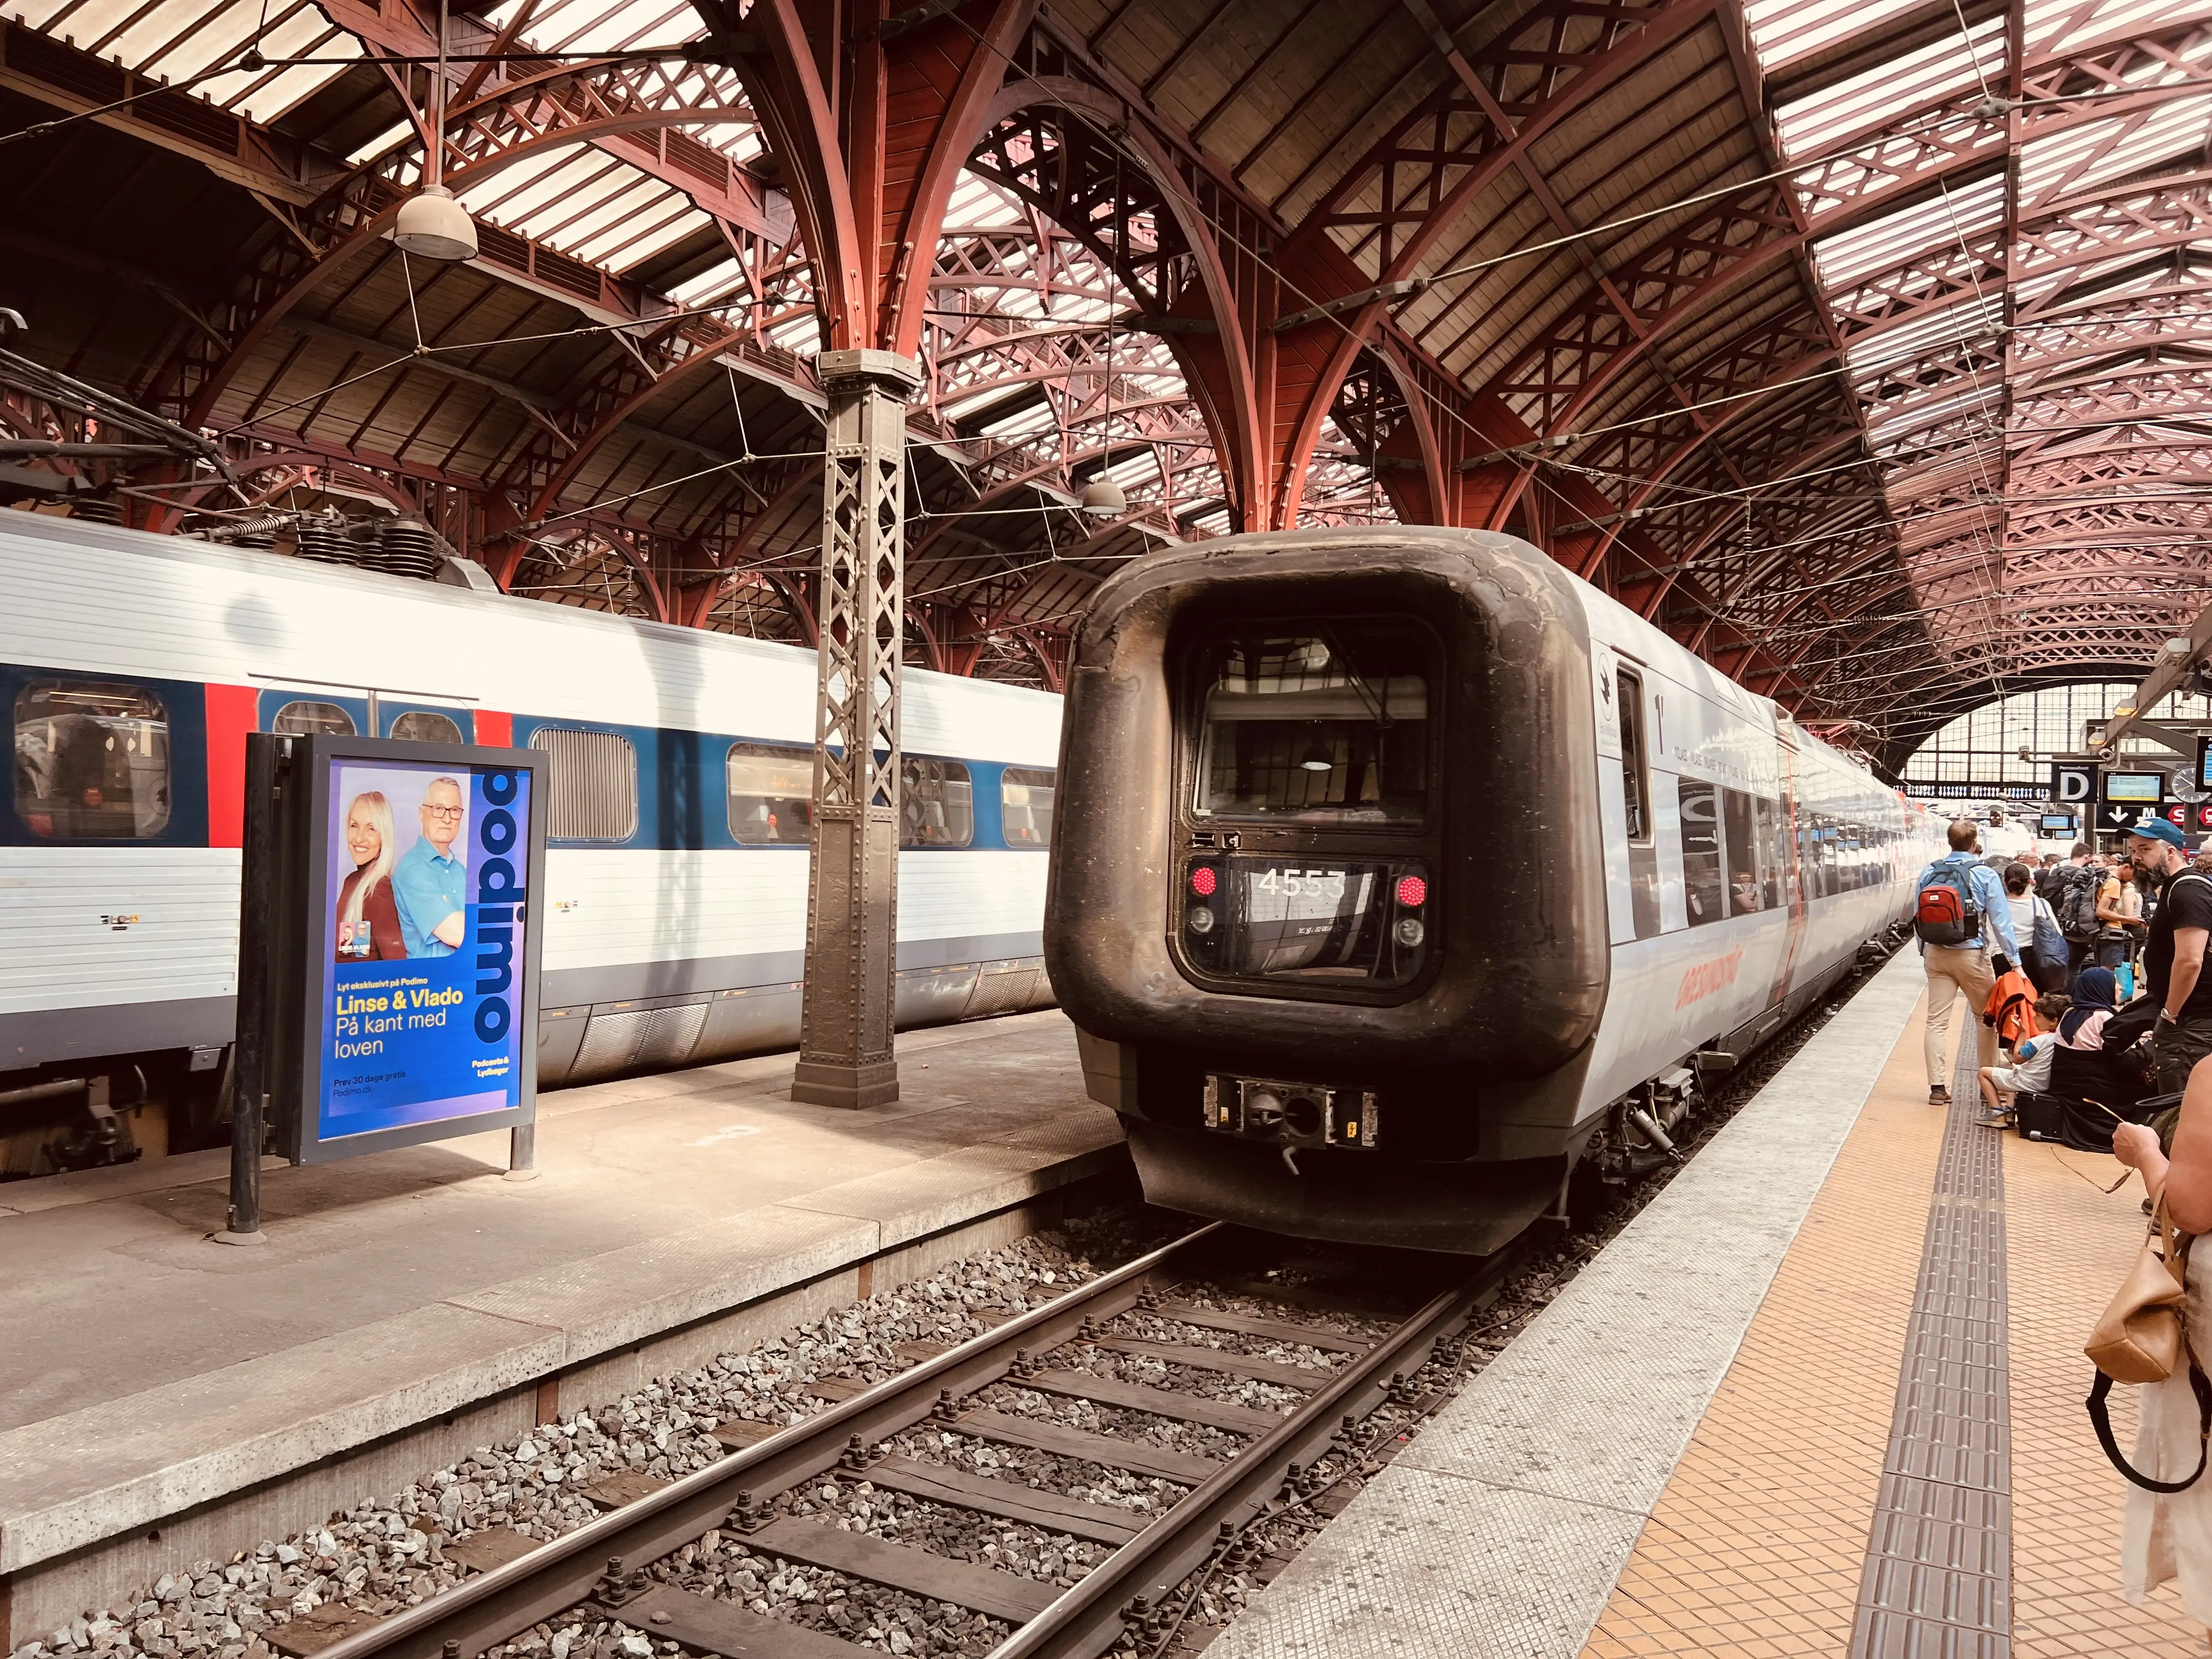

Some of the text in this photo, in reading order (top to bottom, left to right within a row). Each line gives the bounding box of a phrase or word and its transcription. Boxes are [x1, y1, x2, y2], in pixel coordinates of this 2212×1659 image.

[2060, 772, 2089, 800] D
[1258, 868, 1346, 898] 4553
[474, 768, 524, 1044] podimo
[337, 977, 428, 992] Lyt eksklusivt på Podimo
[336, 986, 463, 1015] Linse & Vlado
[336, 1007, 446, 1037] På kant med
[335, 1040, 383, 1059] loven
[333, 1086, 372, 1098] Podimo.dk
[334, 1079, 352, 1087] Prøv
[364, 1075, 383, 1084] dage
[385, 1070, 406, 1082] gratis
